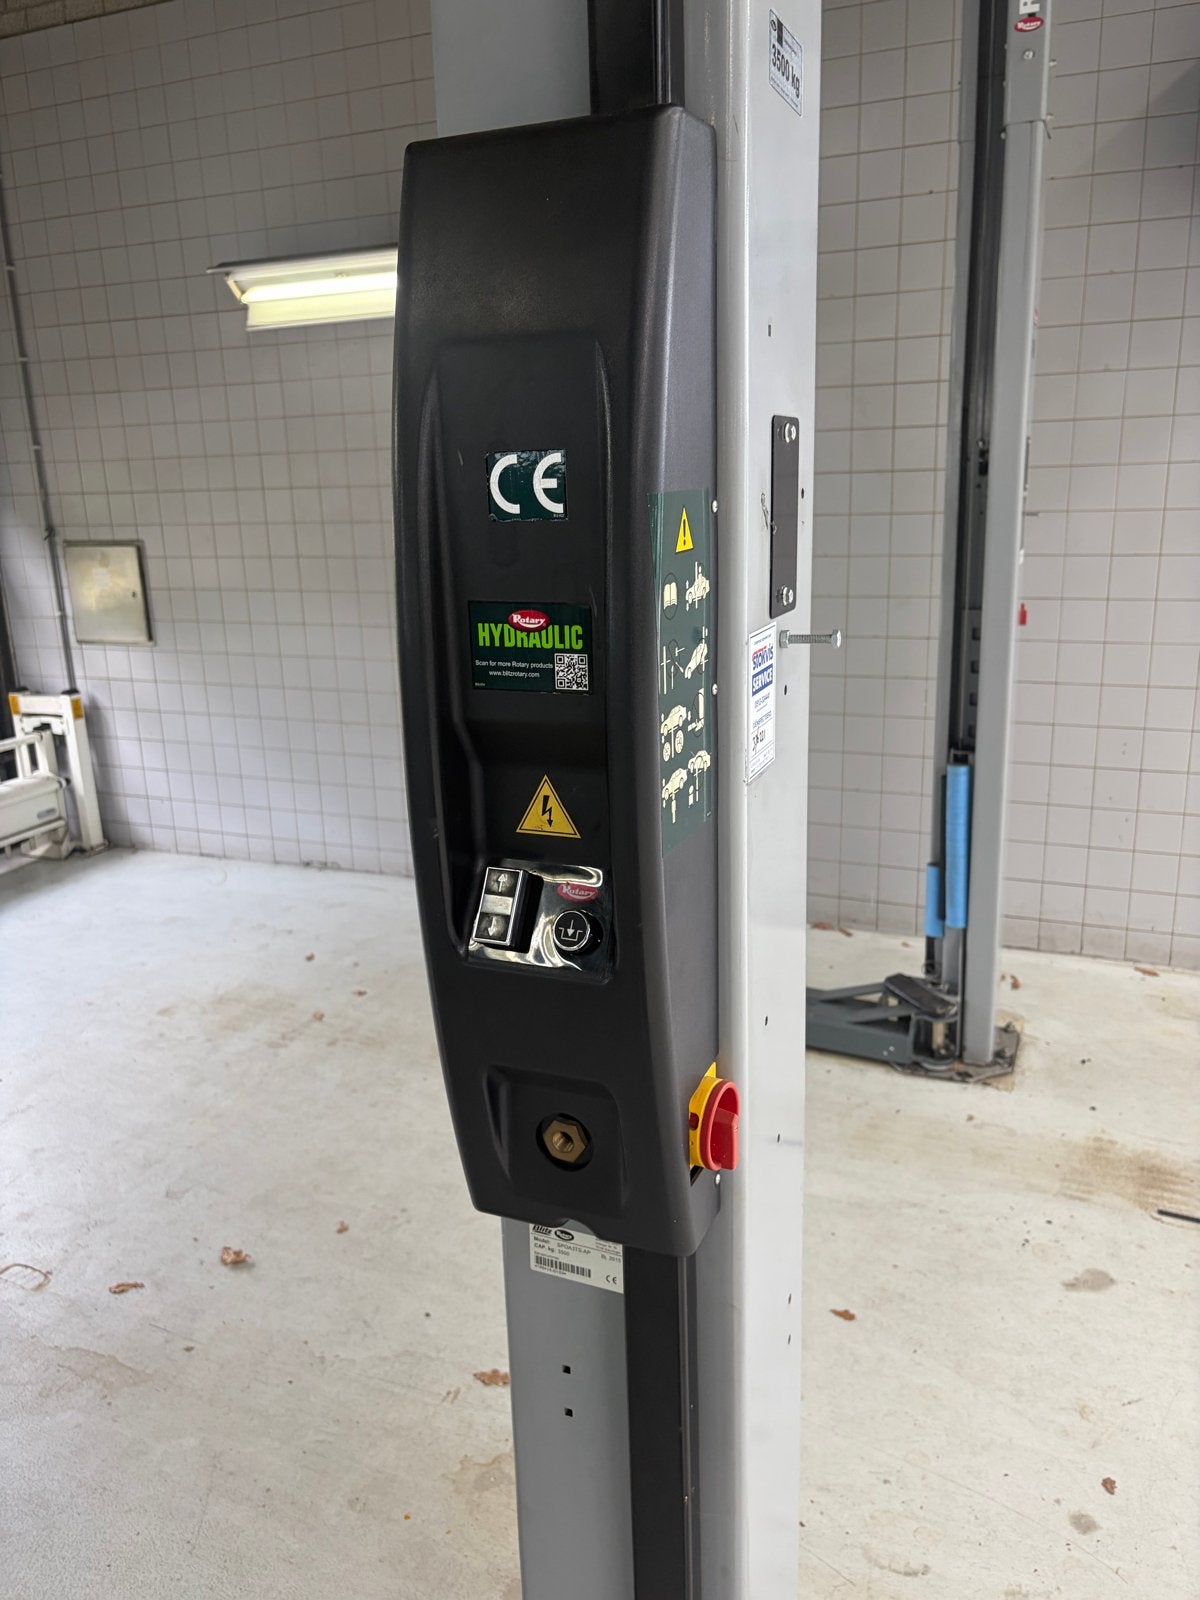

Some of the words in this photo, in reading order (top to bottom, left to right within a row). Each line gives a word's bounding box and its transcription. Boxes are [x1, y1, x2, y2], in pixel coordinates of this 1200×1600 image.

[772, 43, 790, 82] 3500
[791, 65, 800, 99] kg
[490, 452, 564, 515] CE
[511, 613, 546, 629] Rotary
[477, 623, 583, 650] HYDRAULIC
[475, 659, 489, 667] Scan
[511, 661, 529, 669] Rotary
[489, 670, 540, 678] www.blitzrotary.com
[752, 667, 773, 692] SERVICE
[562, 883, 595, 900] Rotary
[605, 1274, 617, 1285] CE
